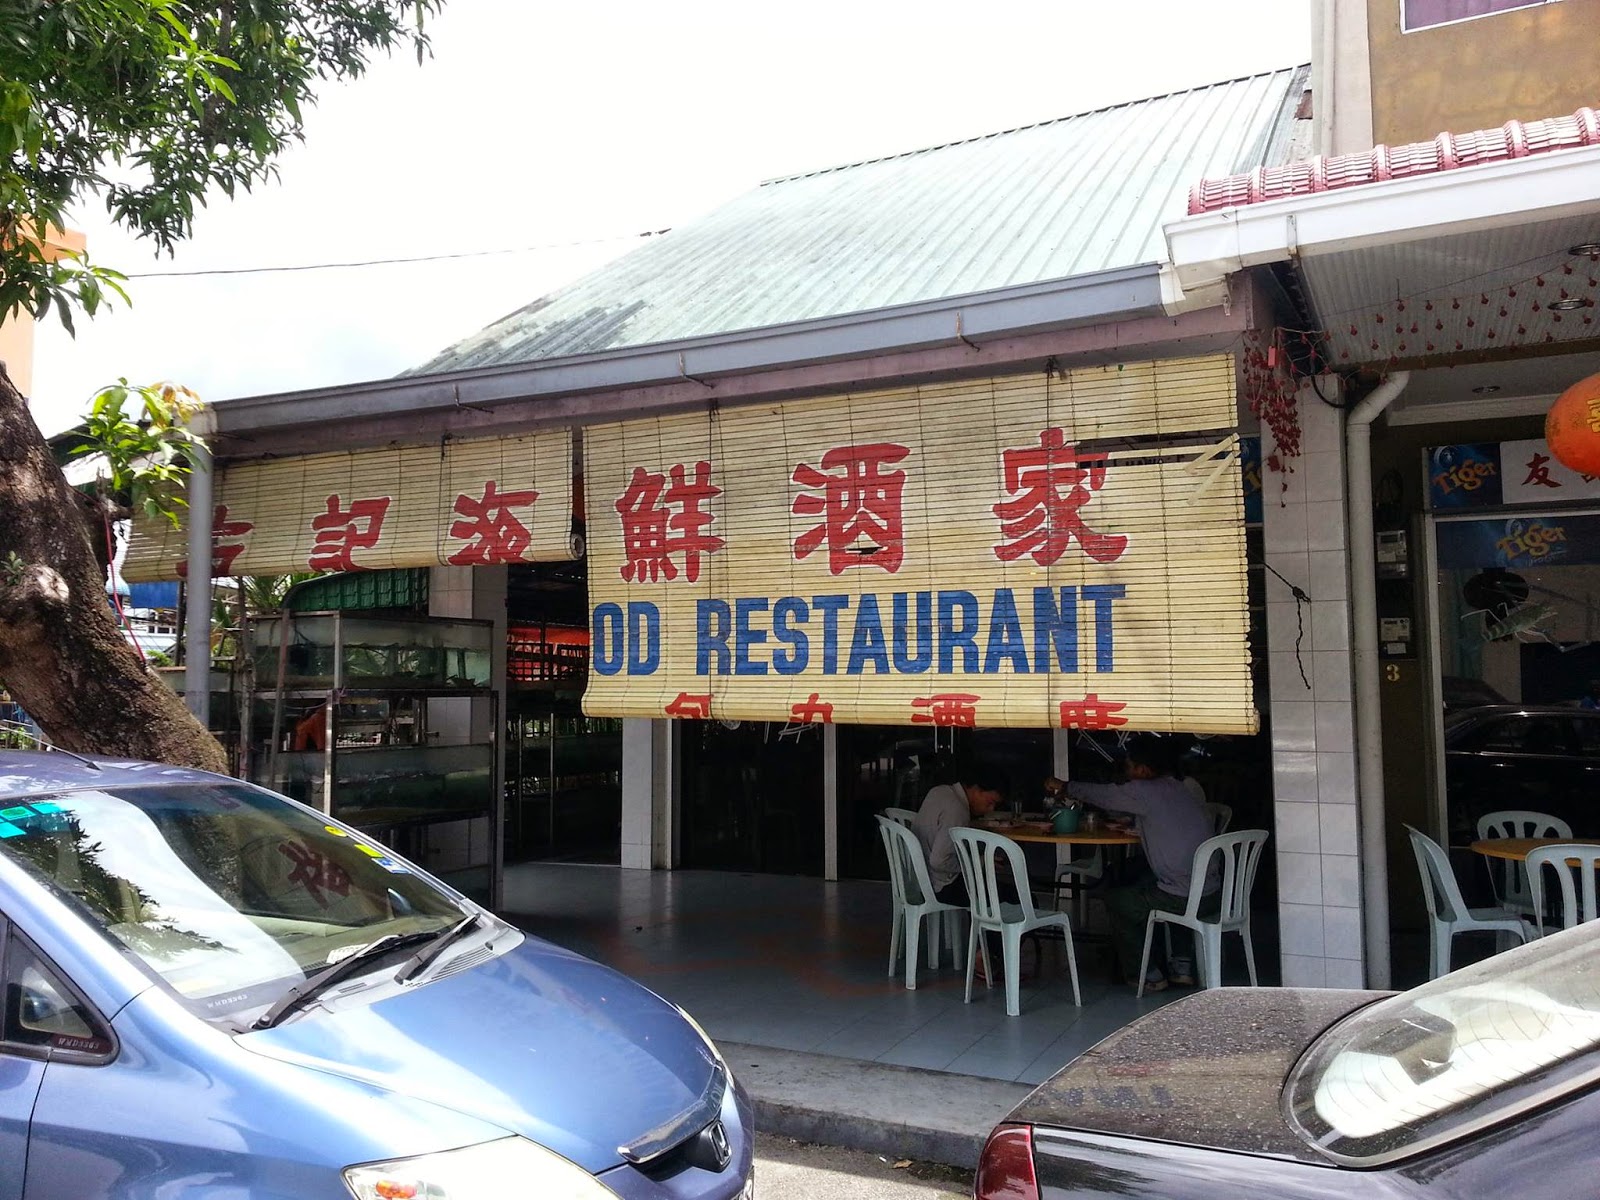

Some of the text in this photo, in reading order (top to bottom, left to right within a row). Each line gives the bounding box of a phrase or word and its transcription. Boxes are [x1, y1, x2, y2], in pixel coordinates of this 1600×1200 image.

[1432, 459, 1497, 495] Tiger
[1496, 523, 1568, 558] Tiger
[592, 583, 1126, 676] OD RESTAURANT
[1386, 664, 1400, 682] 3
